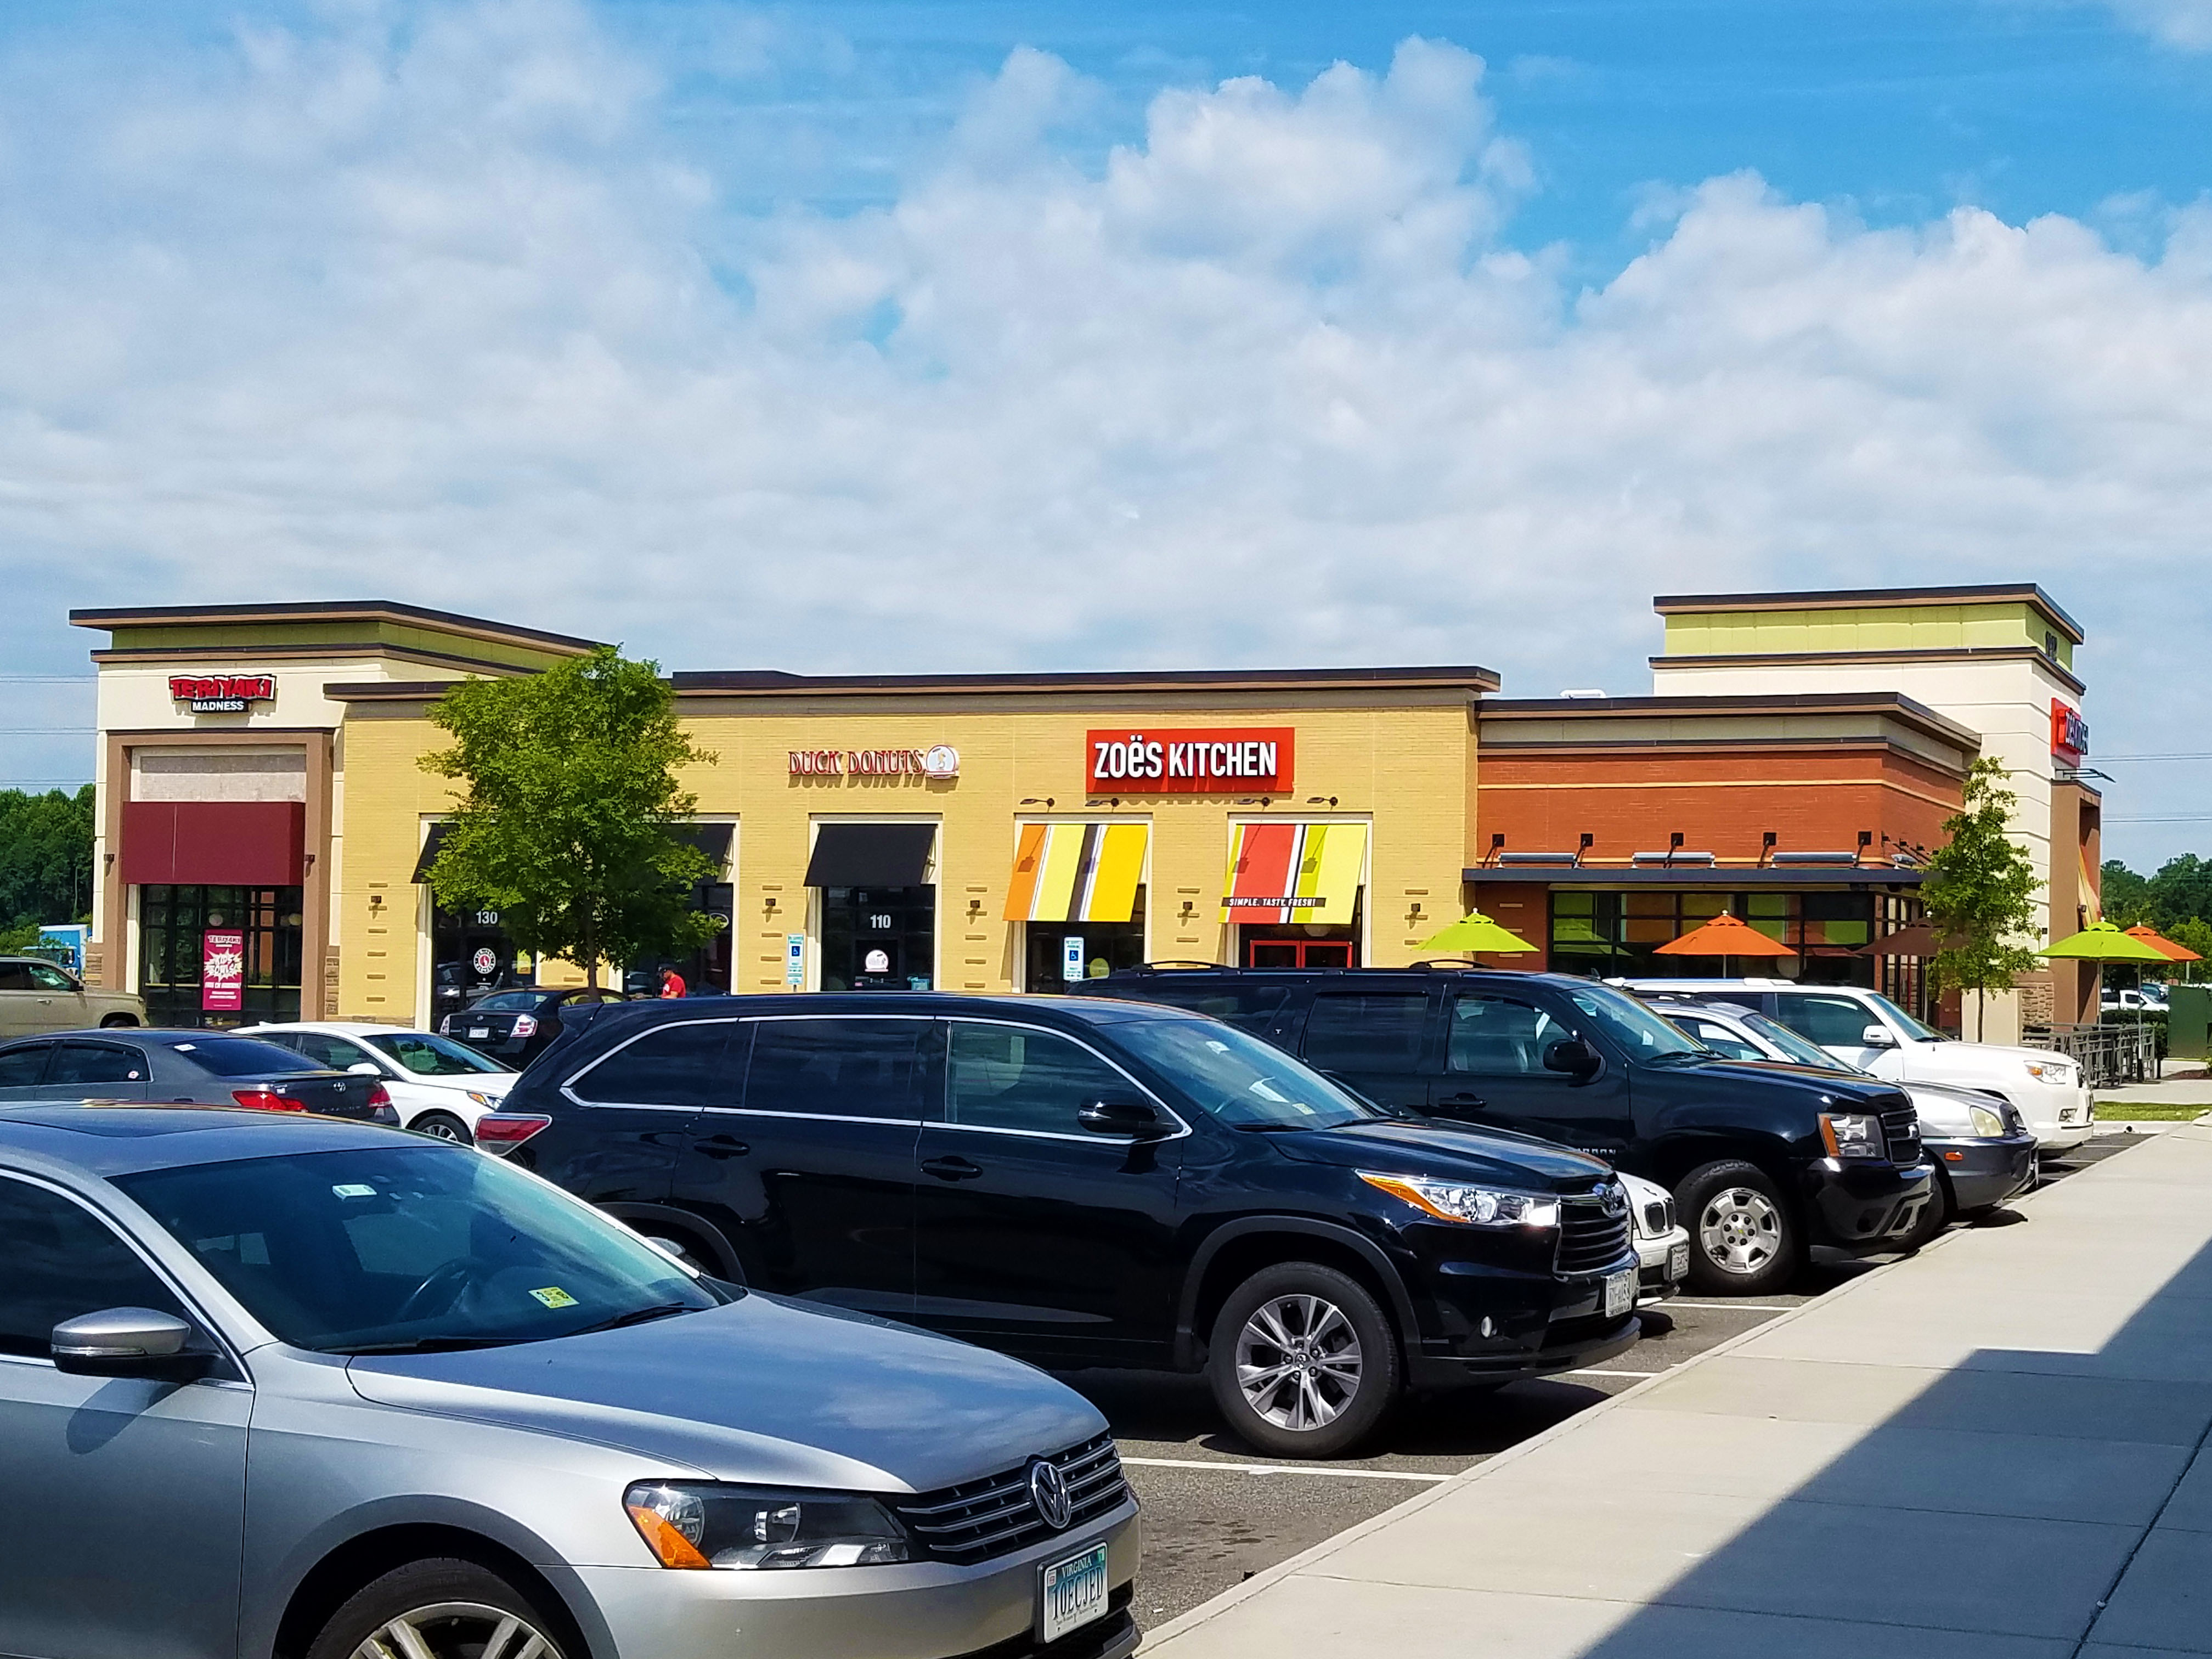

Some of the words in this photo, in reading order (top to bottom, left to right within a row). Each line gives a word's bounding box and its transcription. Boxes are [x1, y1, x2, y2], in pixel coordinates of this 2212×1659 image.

[170, 678, 272, 698] TERIYAKI
[193, 701, 245, 711] MADNESS
[788, 750, 841, 775] DUCK
[848, 749, 924, 775] DONUTS
[1169, 742, 1277, 777] KITCHEN
[1288, 898, 1316, 907] FRESH!
[476, 911, 498, 924] 130
[870, 915, 891, 928] 110
[1062, 1555, 1092, 1579] VIRGINIA
